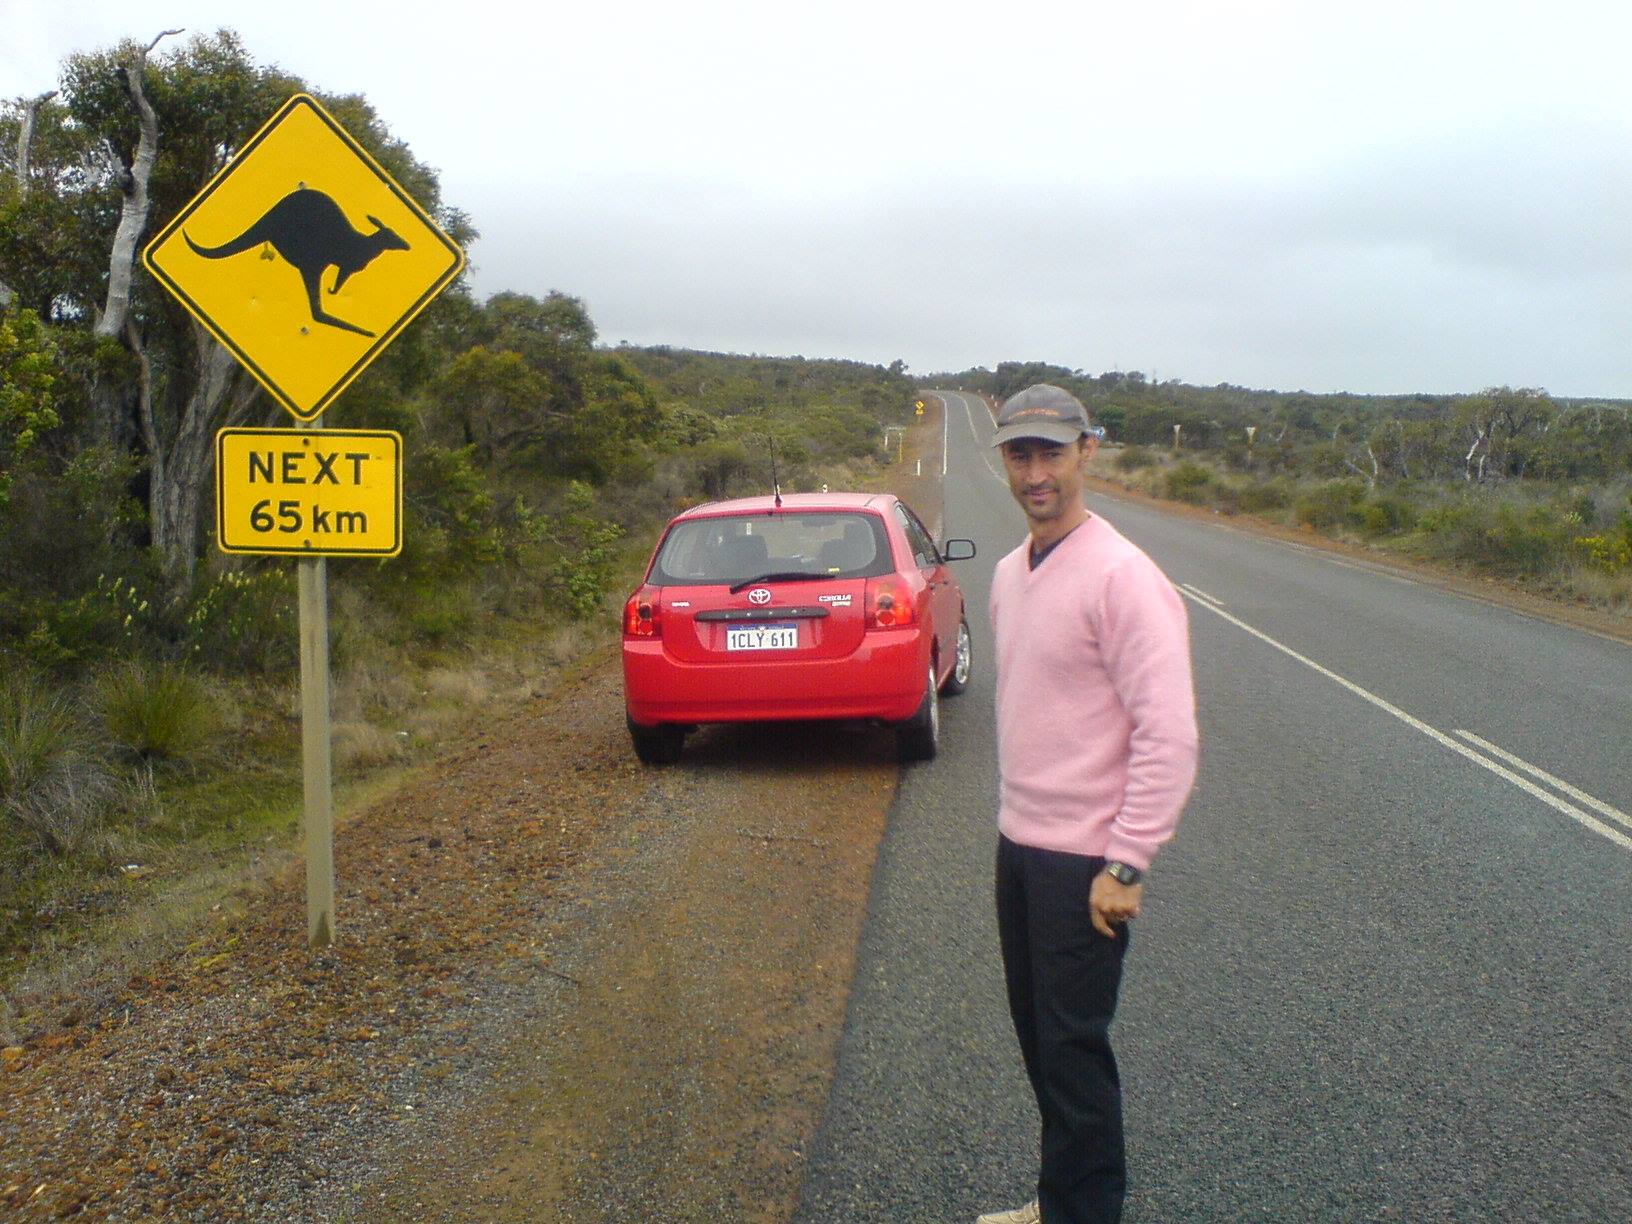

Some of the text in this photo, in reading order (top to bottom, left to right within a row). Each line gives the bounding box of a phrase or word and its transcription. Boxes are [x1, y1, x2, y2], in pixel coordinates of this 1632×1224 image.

[249, 451, 370, 485] NEXT
[250, 499, 368, 533] 65 km
